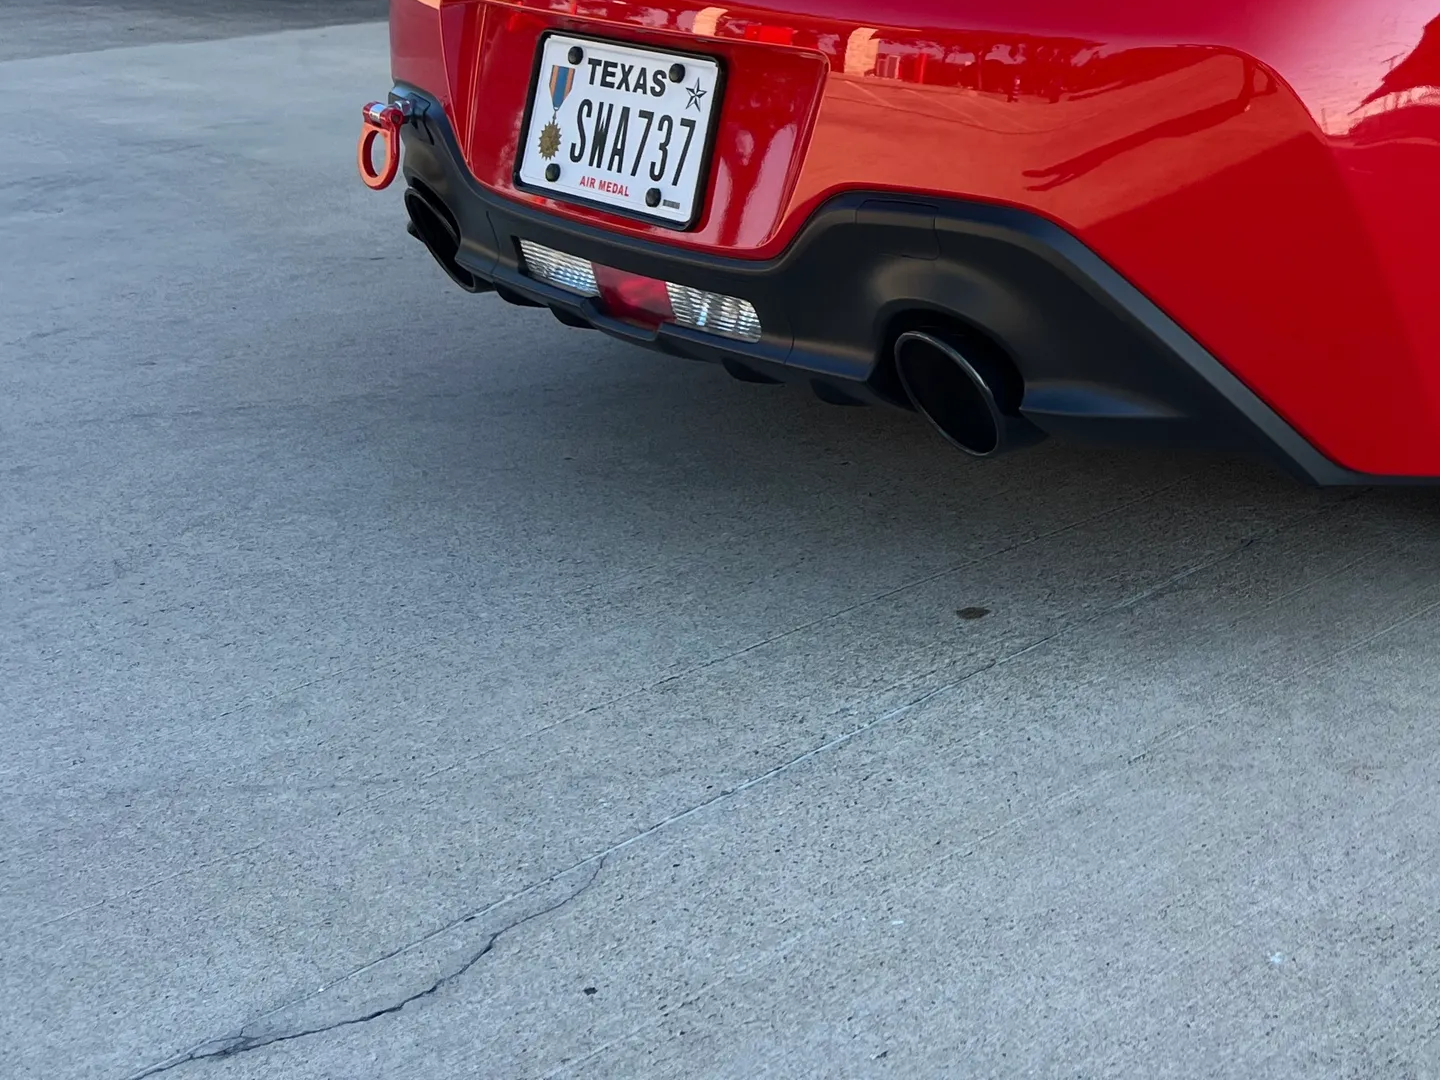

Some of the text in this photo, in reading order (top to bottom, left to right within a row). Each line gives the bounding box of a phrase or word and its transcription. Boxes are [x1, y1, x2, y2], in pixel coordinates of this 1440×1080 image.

[588, 57, 667, 97] TEXAS
[569, 98, 697, 187] SWA737
[579, 175, 630, 197] AIR MEDAL
